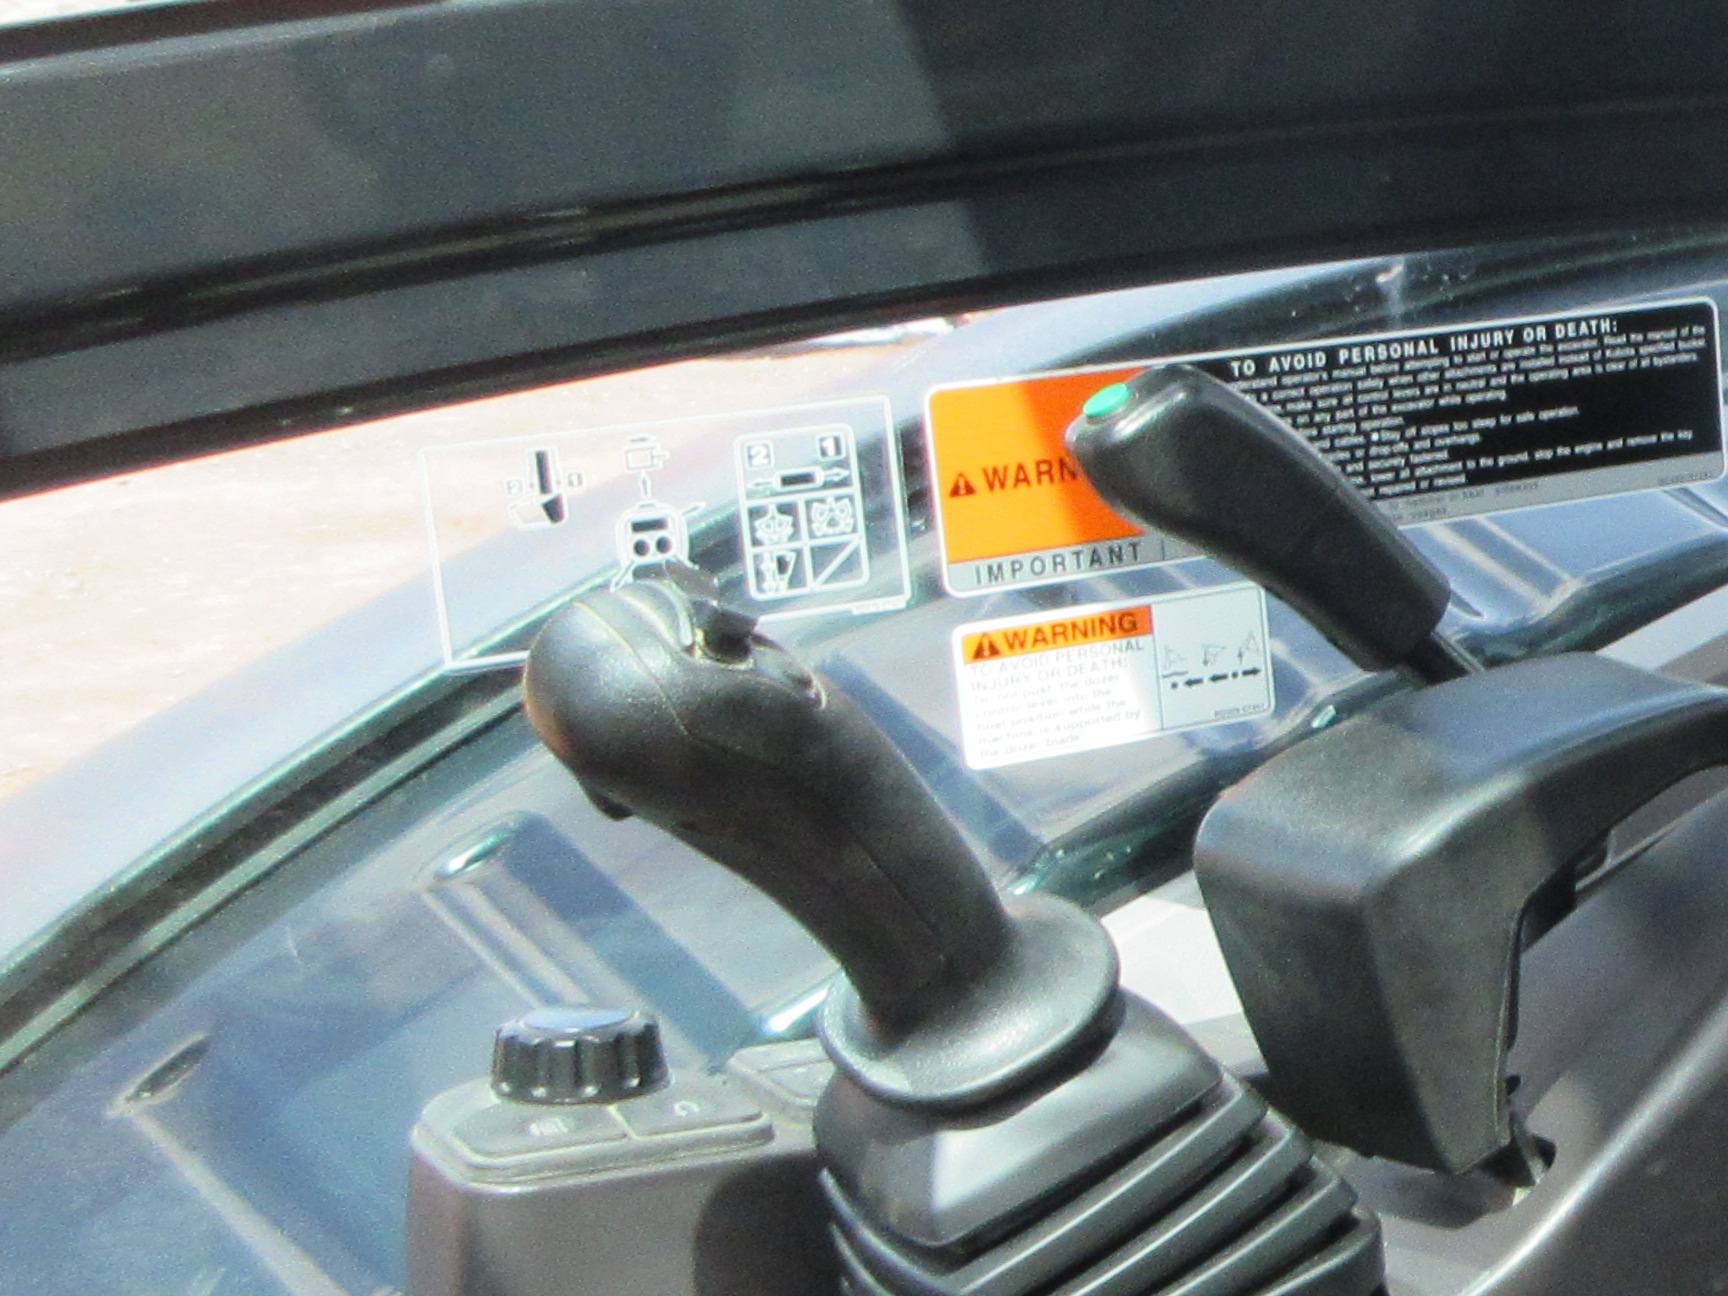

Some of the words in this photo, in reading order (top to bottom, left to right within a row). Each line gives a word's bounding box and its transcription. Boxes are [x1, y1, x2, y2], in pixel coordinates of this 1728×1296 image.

[1231, 358, 1255, 377] TO
[1269, 350, 1326, 373] AVOID
[1340, 337, 1438, 365] PERSONAL
[1451, 329, 1513, 352] INJURY
[1523, 325, 1546, 344] OR
[1555, 317, 1617, 340] DEATH:
[820, 436, 837, 458] 1
[975, 542, 1141, 585] IMPORTANT
[1004, 611, 1139, 651] WARNING
[971, 664, 991, 678] TO
[999, 653, 1049, 674] AVOID
[1056, 637, 1144, 665] PERSONAL
[971, 673, 1030, 694] INJURY
[1038, 667, 1061, 682] OR
[1068, 655, 1128, 678] DEATH:
[1093, 686, 1112, 698] the
[1107, 697, 1126, 710] the
[1056, 712, 1120, 734] supported
[1126, 708, 1140, 722] by
